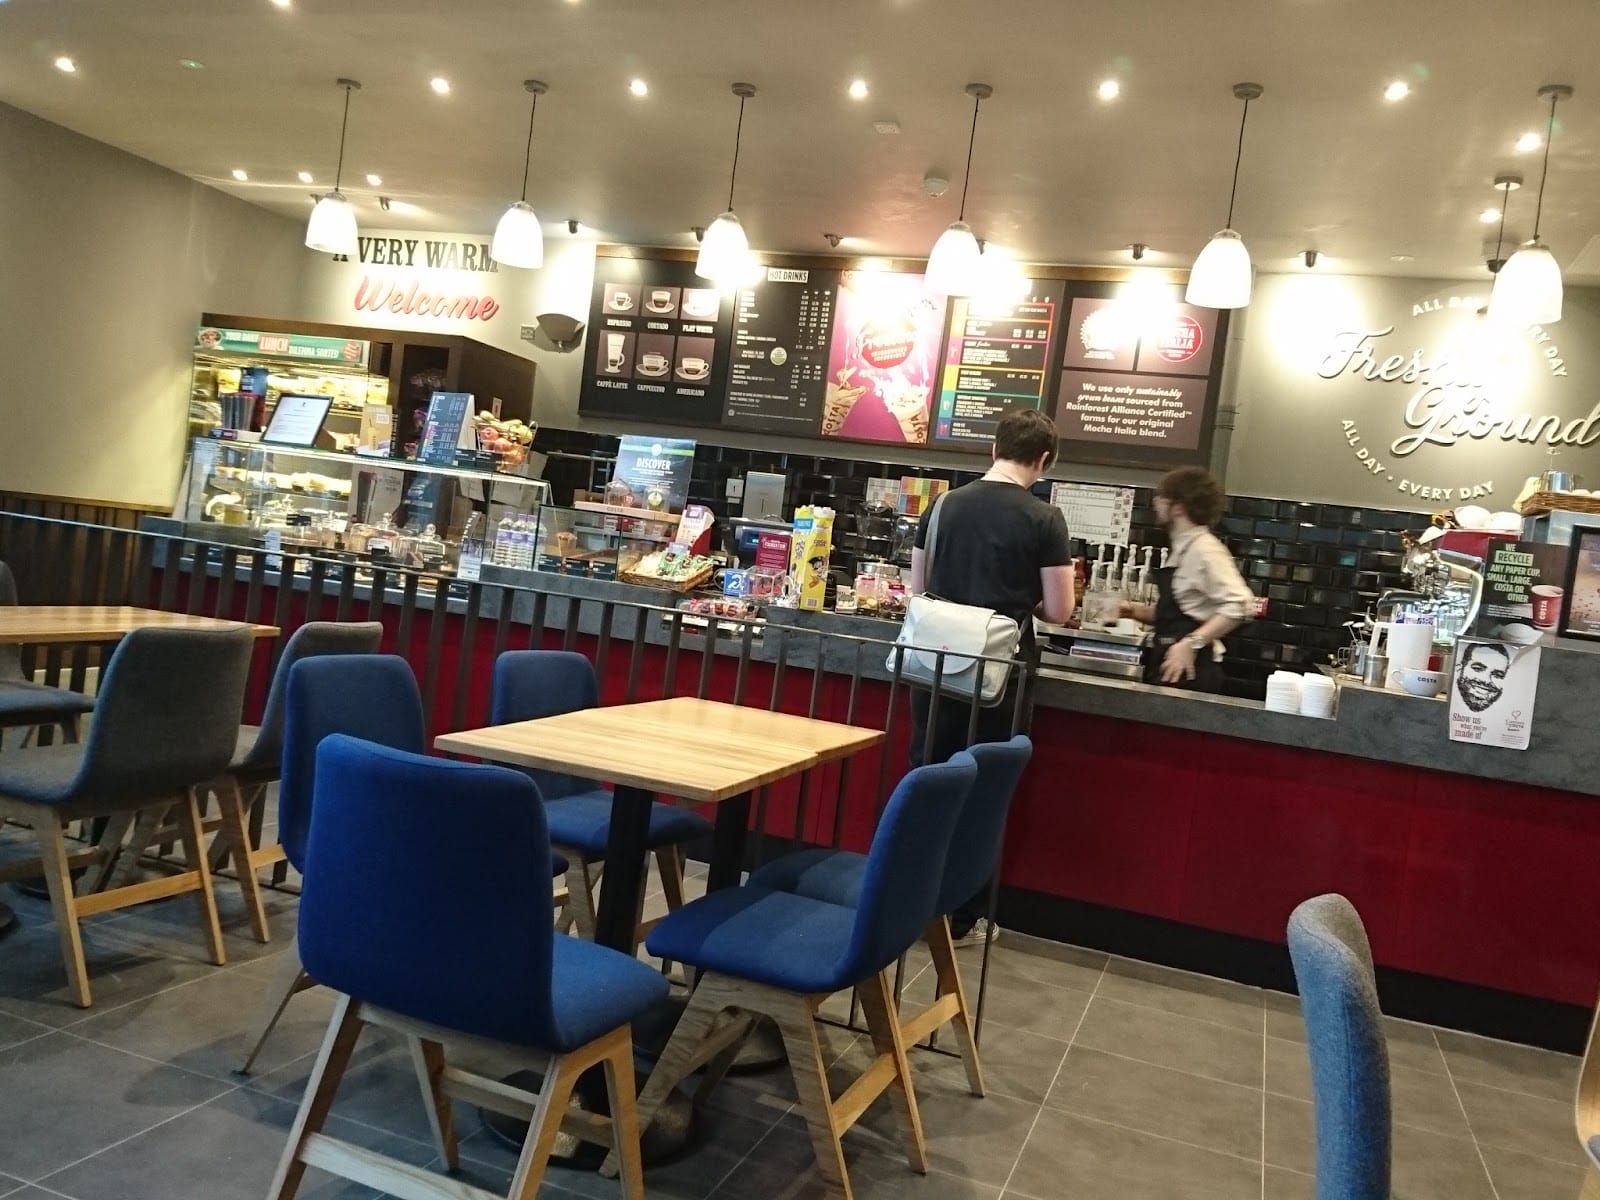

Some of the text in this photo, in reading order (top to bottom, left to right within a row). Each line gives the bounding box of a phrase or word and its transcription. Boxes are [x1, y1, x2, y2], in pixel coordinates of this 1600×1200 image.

[357, 236, 418, 267] VERY
[425, 240, 499, 273] WARM
[783, 271, 808, 281] DRINKS
[353, 275, 500, 322] Welcome
[1412, 298, 1443, 317] ALL
[259, 336, 289, 352] LUNCH
[1543, 345, 1568, 378] DAY
[1082, 383, 1096, 392] We
[1098, 385, 1113, 393] use
[1115, 385, 1134, 396] only
[1066, 402, 1109, 413] Rainforest
[1110, 405, 1145, 416] Alliance
[1126, 397, 1160, 407] sourced
[1161, 399, 1183, 408] from
[1081, 413, 1105, 423] farms
[1107, 415, 1120, 424] for
[1139, 418, 1174, 429] original
[1083, 424, 1167, 438] Mocha Italia blend.
[636, 458, 672, 471] DISCOVER
[1341, 418, 1495, 500] ALL DAY EVERY DAY
[1505, 543, 1517, 552] WE
[1498, 552, 1532, 564] RECYCLE
[1490, 564, 1541, 577] ANY PAPER CUP.
[1487, 573, 1533, 586] SMALL, LARGE,
[1494, 583, 1525, 594] COSTA OR
[1507, 593, 1529, 603] OTHER
[1539, 600, 1548, 620] COSTA
[1417, 676, 1437, 684] COSTA
[1452, 712, 1481, 725] Show us
[1454, 729, 1474, 739] made
